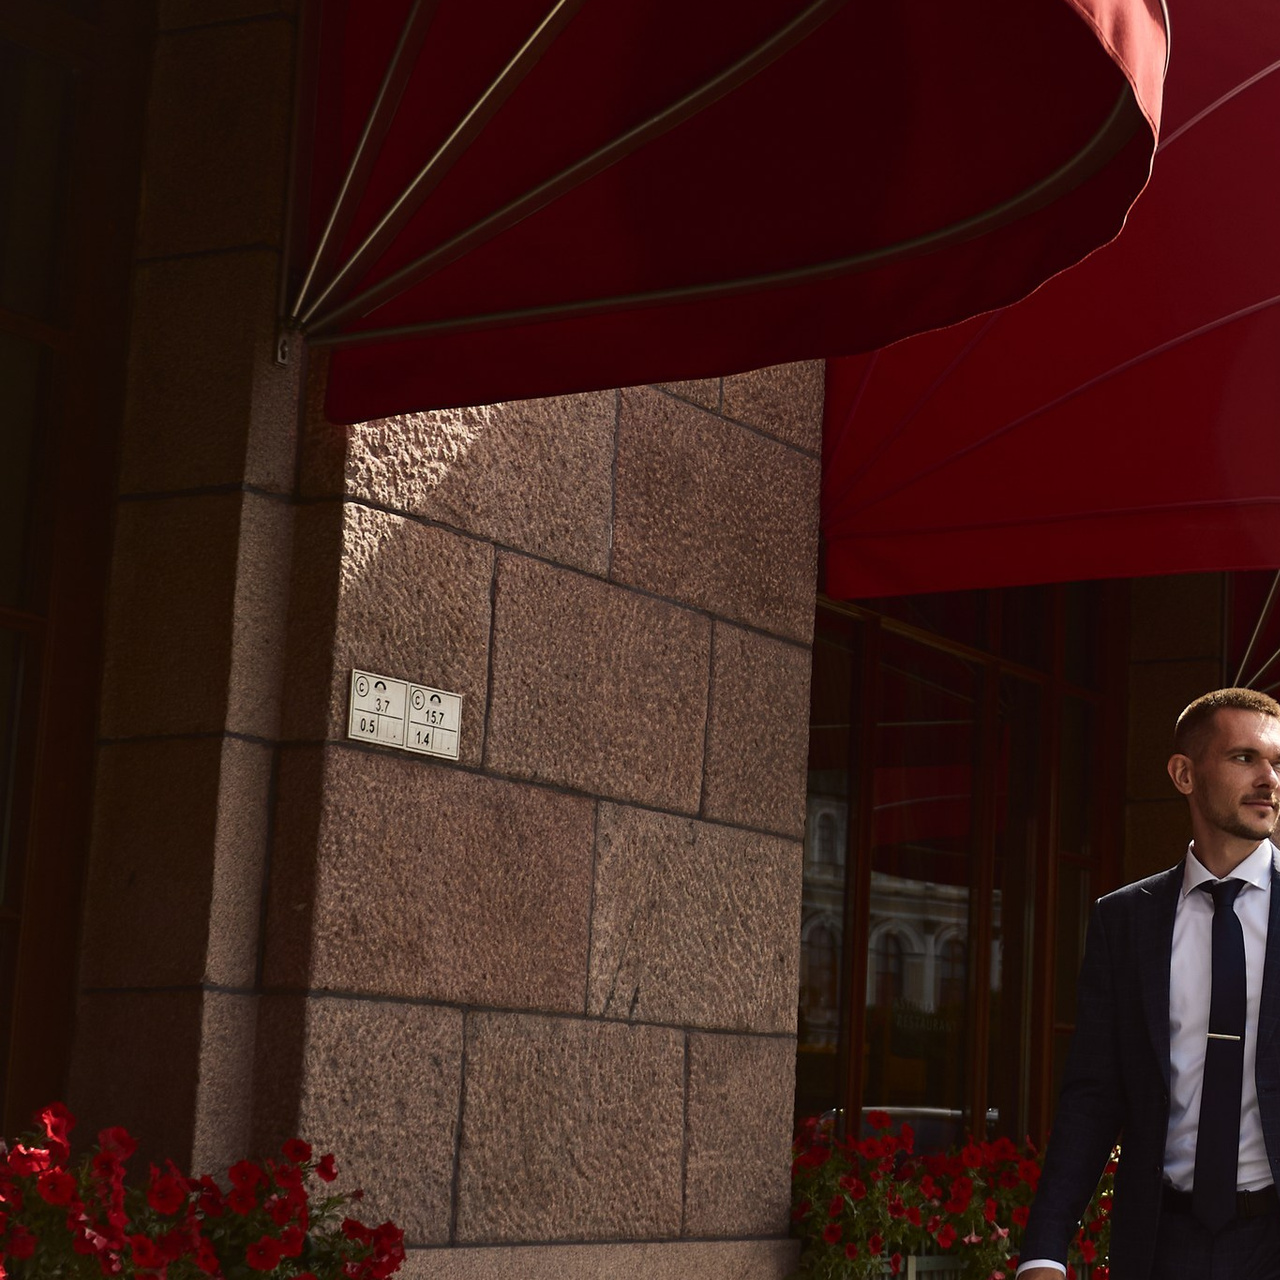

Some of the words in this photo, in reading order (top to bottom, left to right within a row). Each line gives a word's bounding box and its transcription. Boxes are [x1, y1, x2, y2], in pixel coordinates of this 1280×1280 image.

[375, 698, 390, 713] 3.7
[425, 709, 445, 726] 15.7
[360, 718, 375, 734] 0.5
[416, 730, 430, 746] 1.4
